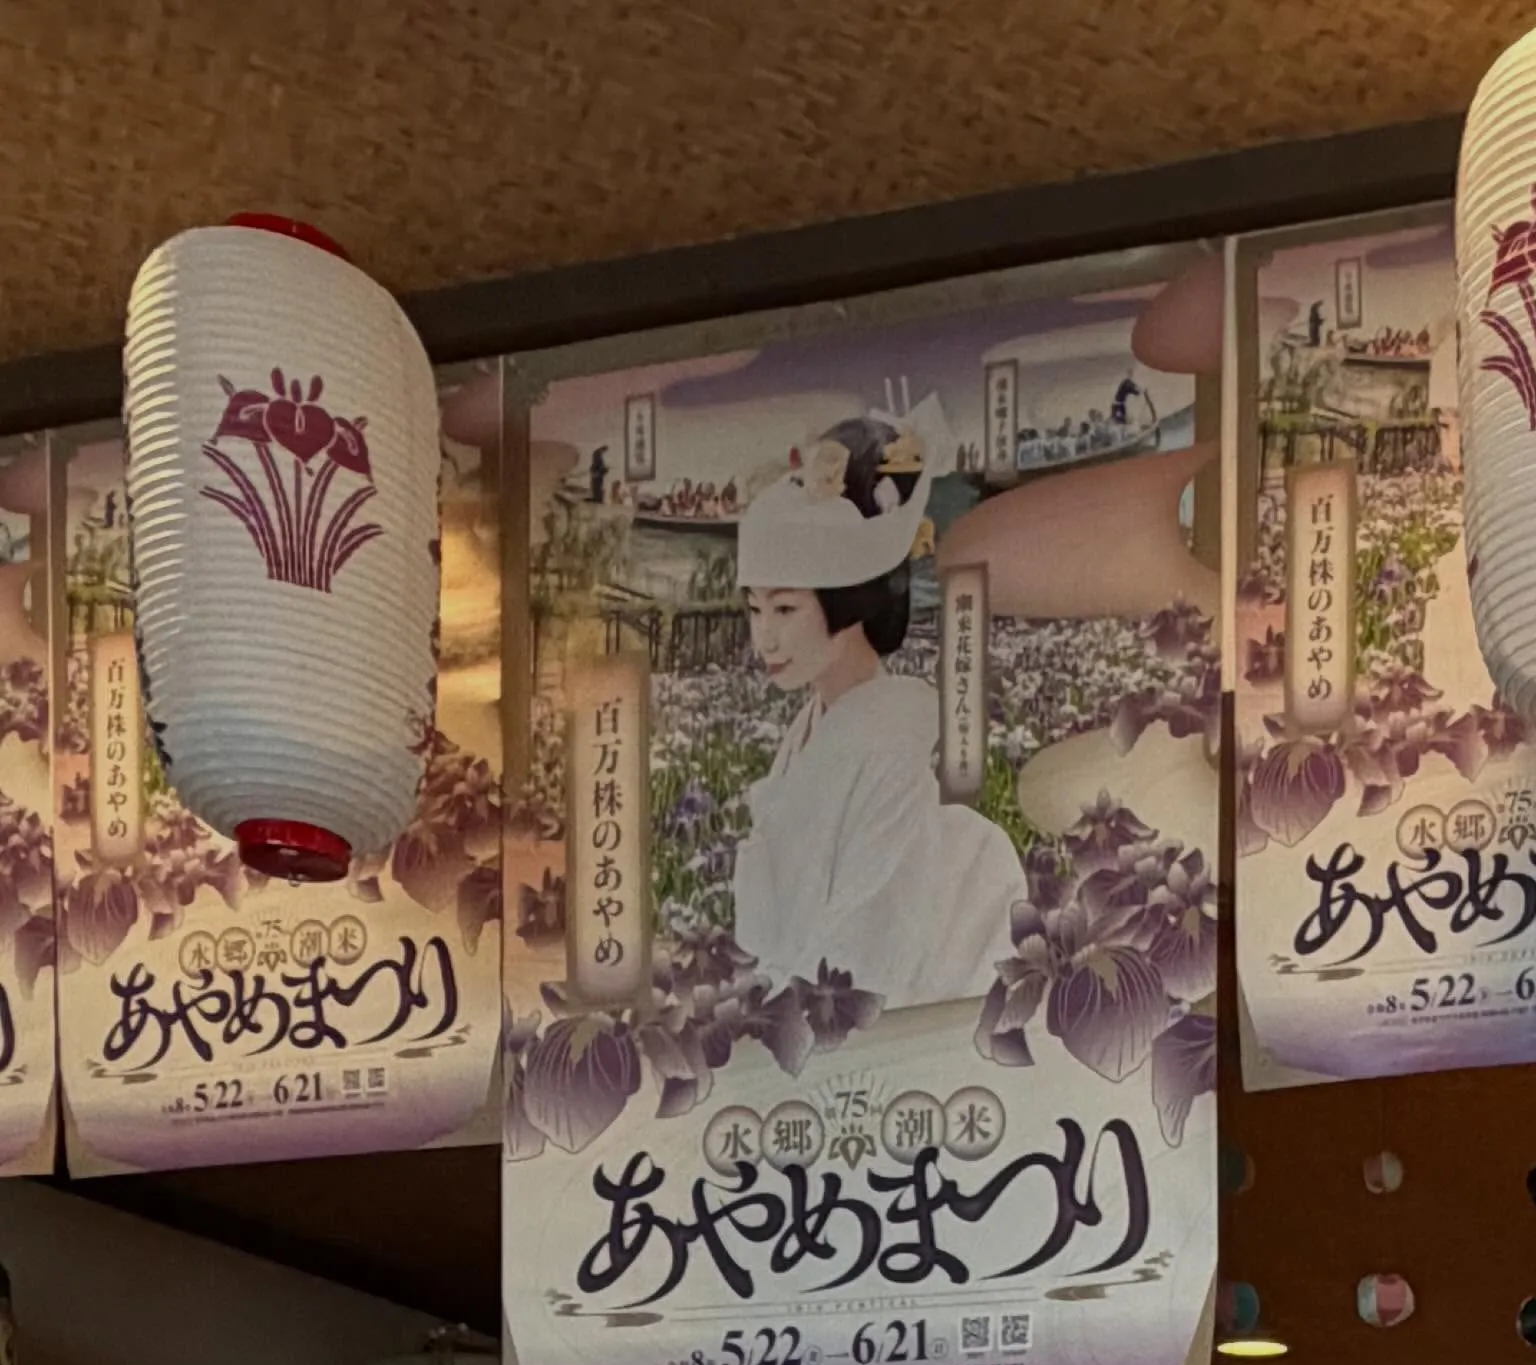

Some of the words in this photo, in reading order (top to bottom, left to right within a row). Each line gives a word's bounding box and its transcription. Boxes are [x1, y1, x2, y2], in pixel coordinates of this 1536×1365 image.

[1308, 496, 1334, 697] 百万株のあやめ
[106, 658, 128, 840] 百万株のあやめ
[592, 702, 625, 968] 百万株のあやめ
[103, 936, 458, 1072] あやめまつり
[578, 1117, 1150, 1310] あやめまつり
